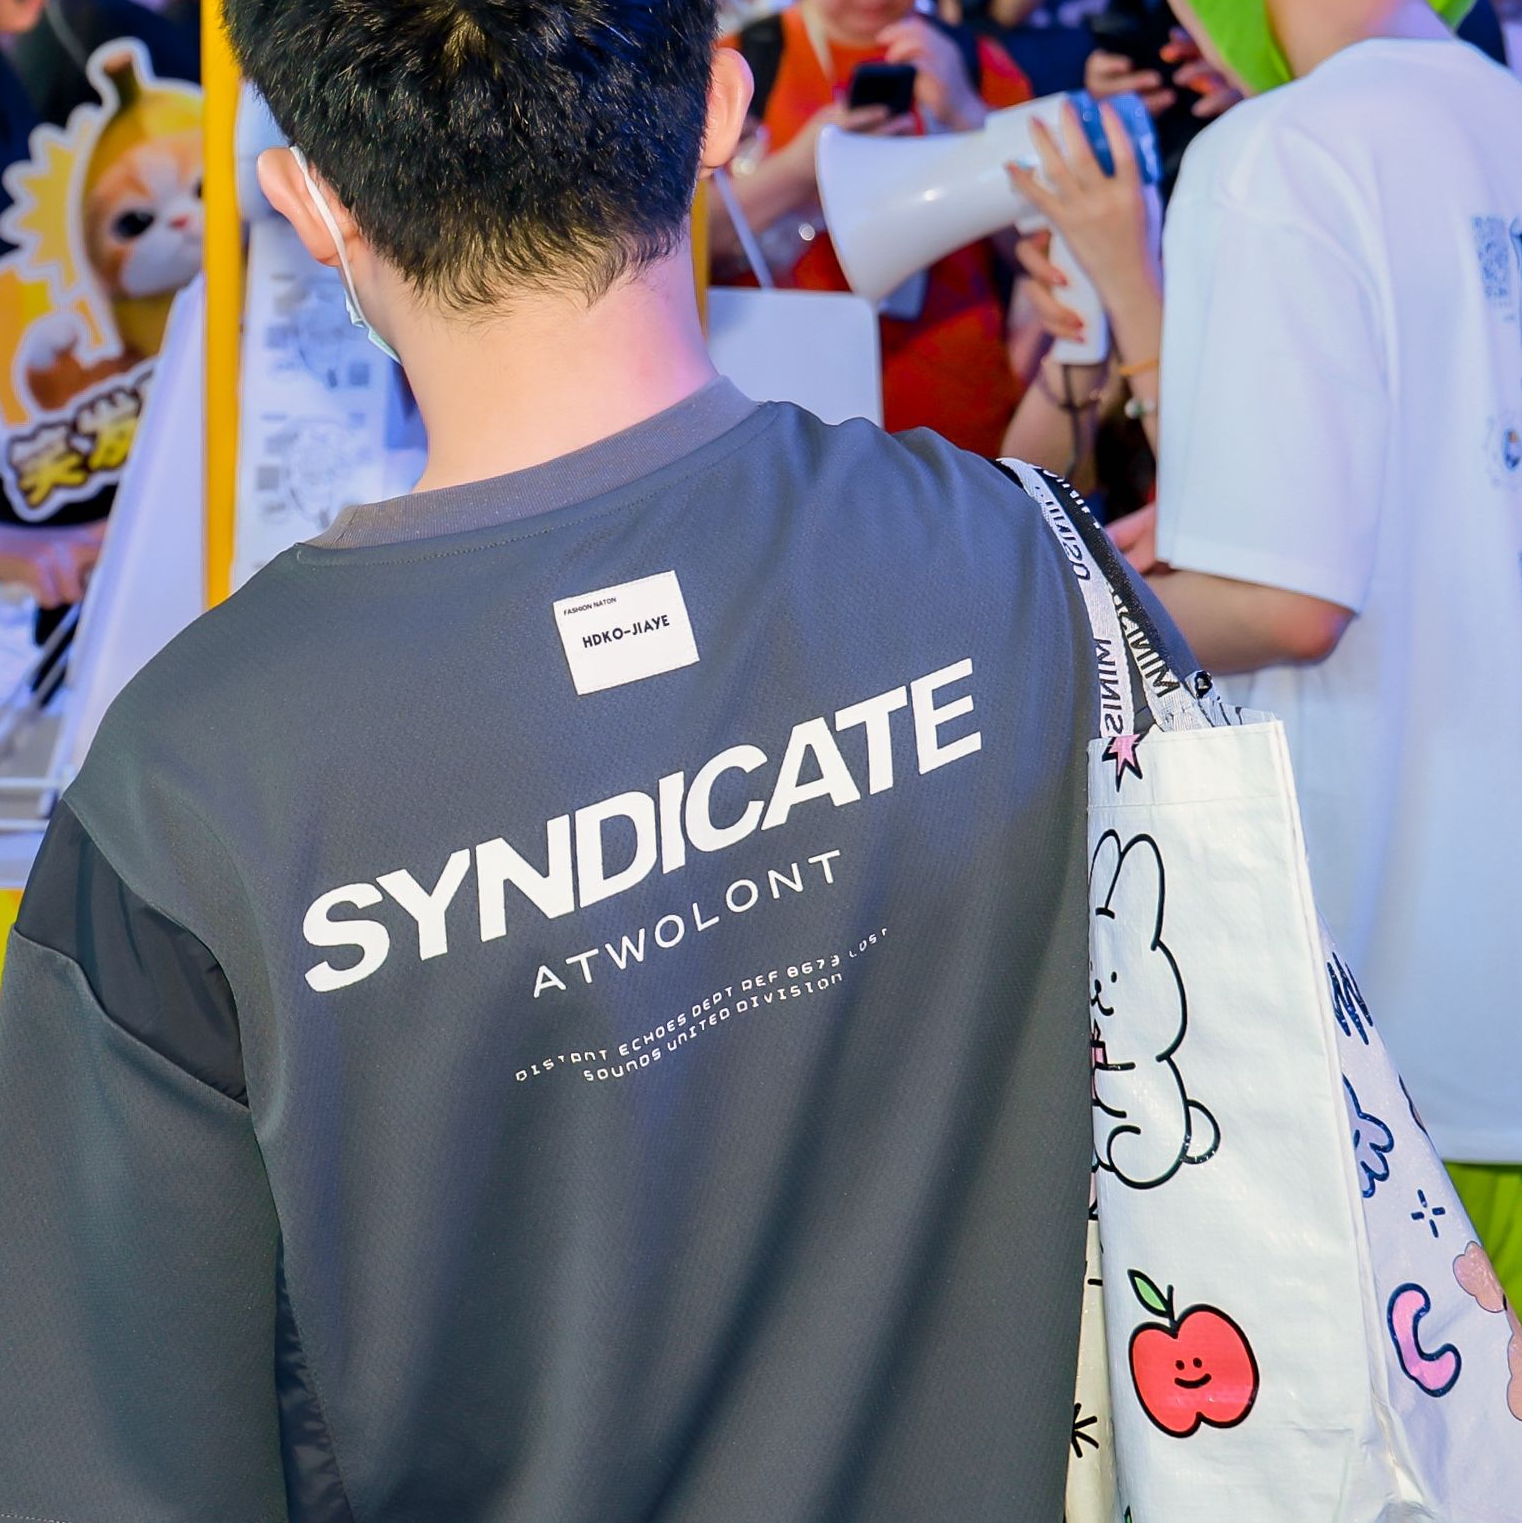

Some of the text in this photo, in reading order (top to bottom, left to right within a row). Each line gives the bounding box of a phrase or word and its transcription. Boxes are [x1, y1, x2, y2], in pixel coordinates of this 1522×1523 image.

[563, 604, 592, 616] FASHION
[582, 614, 670, 648] HDKO-JIAYE
[302, 657, 982, 994] SYNDICATE
[533, 849, 841, 999] ATWOLONT
[618, 1013, 687, 1057] ECHOES
